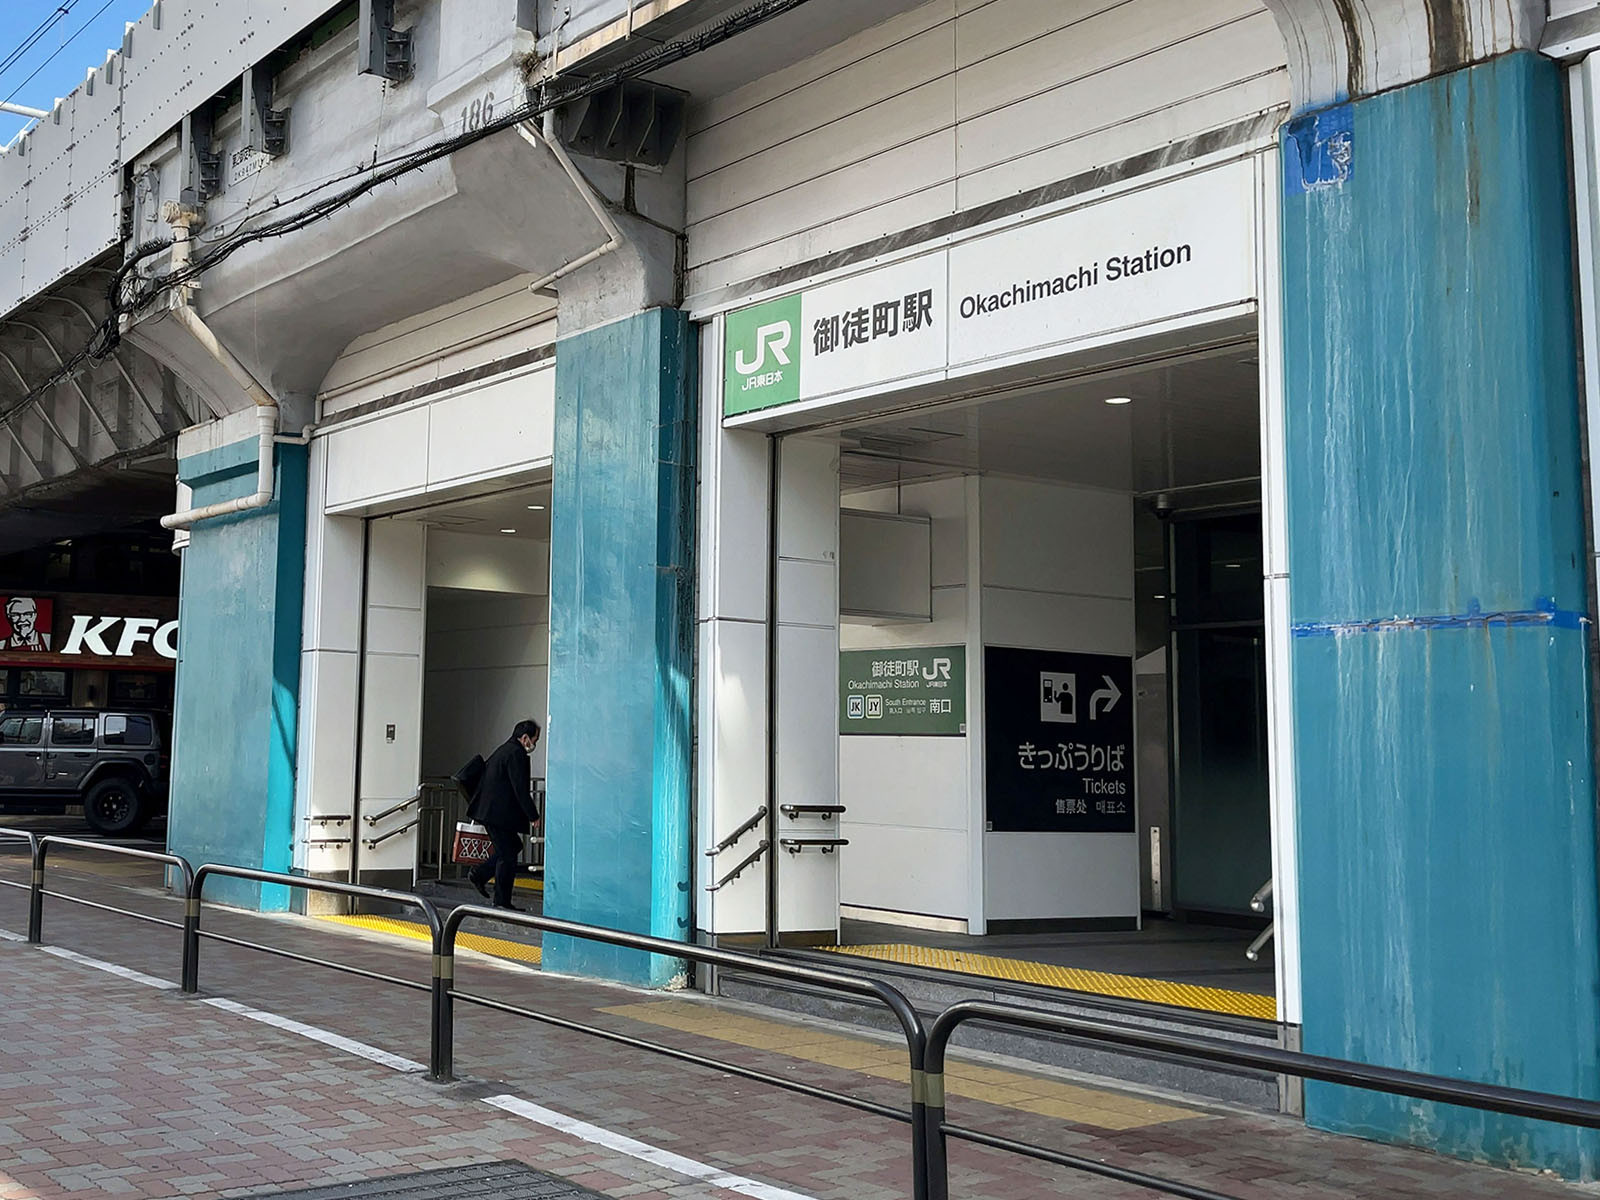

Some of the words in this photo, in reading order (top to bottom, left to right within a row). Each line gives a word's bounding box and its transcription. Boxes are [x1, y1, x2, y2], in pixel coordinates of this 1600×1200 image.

[959, 262, 1099, 319] Okachimachi
[1105, 243, 1192, 281] Station
[813, 288, 933, 356] 御徒町駅
[735, 319, 792, 375] JR
[741, 369, 783, 391] JR東日本
[871, 659, 919, 677] 御徒町駅
[922, 657, 952, 680] JR
[848, 680, 893, 690] Okachimachi
[894, 679, 920, 689] Station
[851, 702, 861, 712] JK
[869, 702, 879, 712] JY
[885, 698, 901, 706] South
[902, 698, 927, 706] Entrance
[929, 698, 952, 714] 南口
[1018, 741, 1125, 772] きっぷうりば
[1082, 777, 1126, 795] Tickets
[1095, 800, 1127, 815] 매표소
